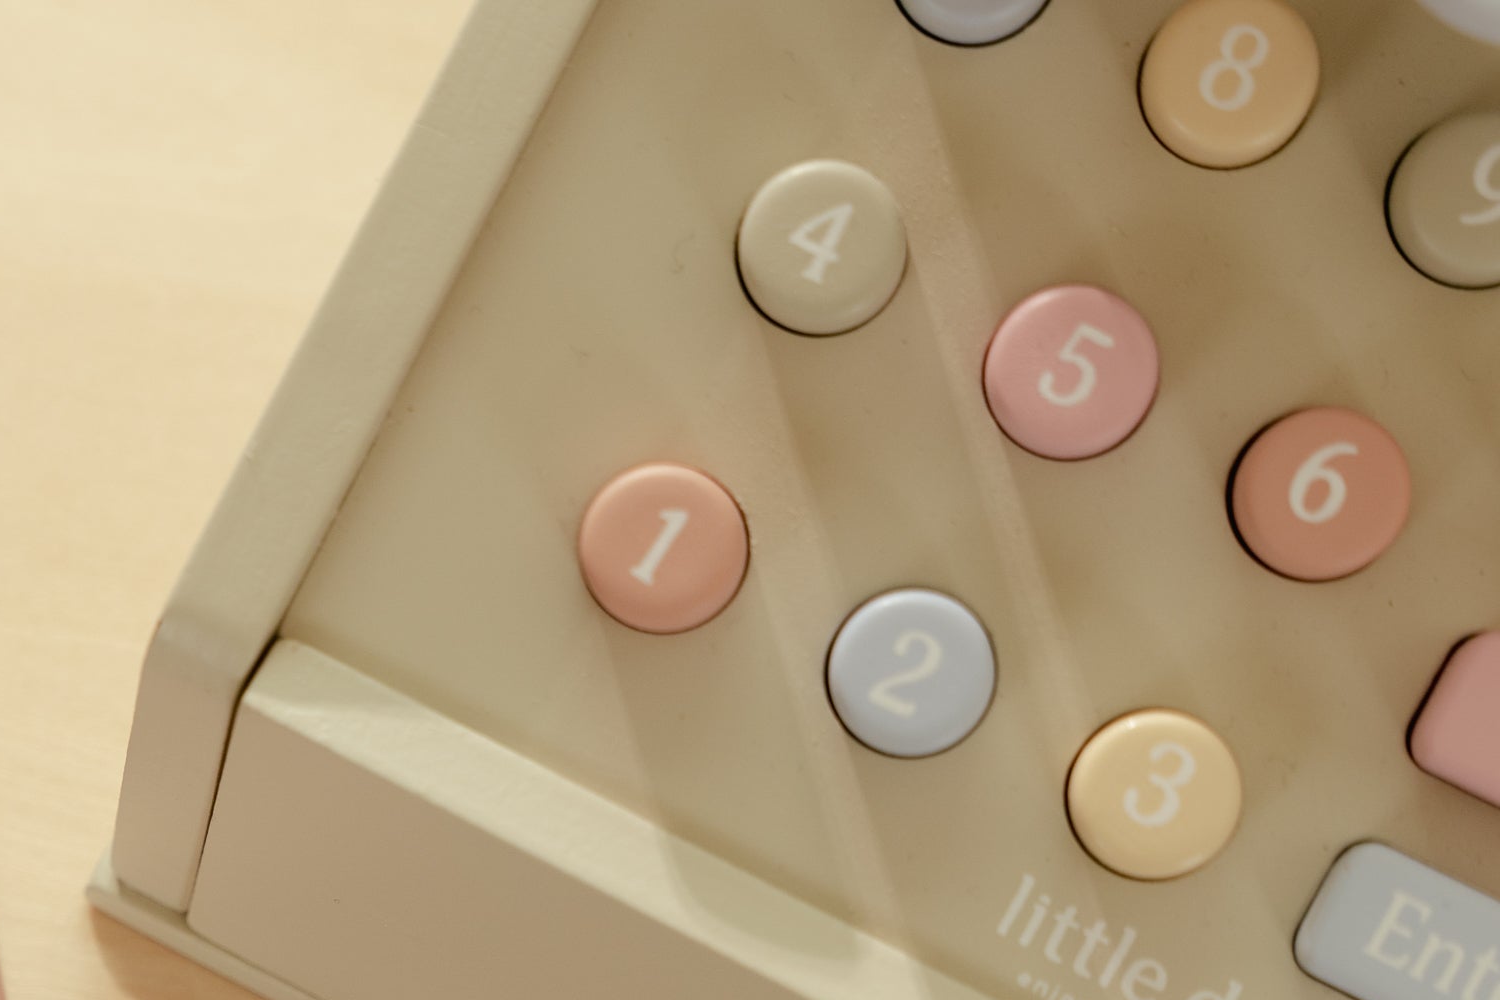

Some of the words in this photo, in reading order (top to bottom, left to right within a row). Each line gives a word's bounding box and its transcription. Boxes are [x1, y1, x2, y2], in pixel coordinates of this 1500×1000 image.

[1199, 24, 1270, 112] 8
[789, 202, 855, 284] 4
[1037, 323, 1115, 408] 5
[1287, 442, 1358, 525] 6
[630, 508, 690, 586] 1
[867, 630, 943, 718] 2
[1123, 741, 1198, 828] 3
